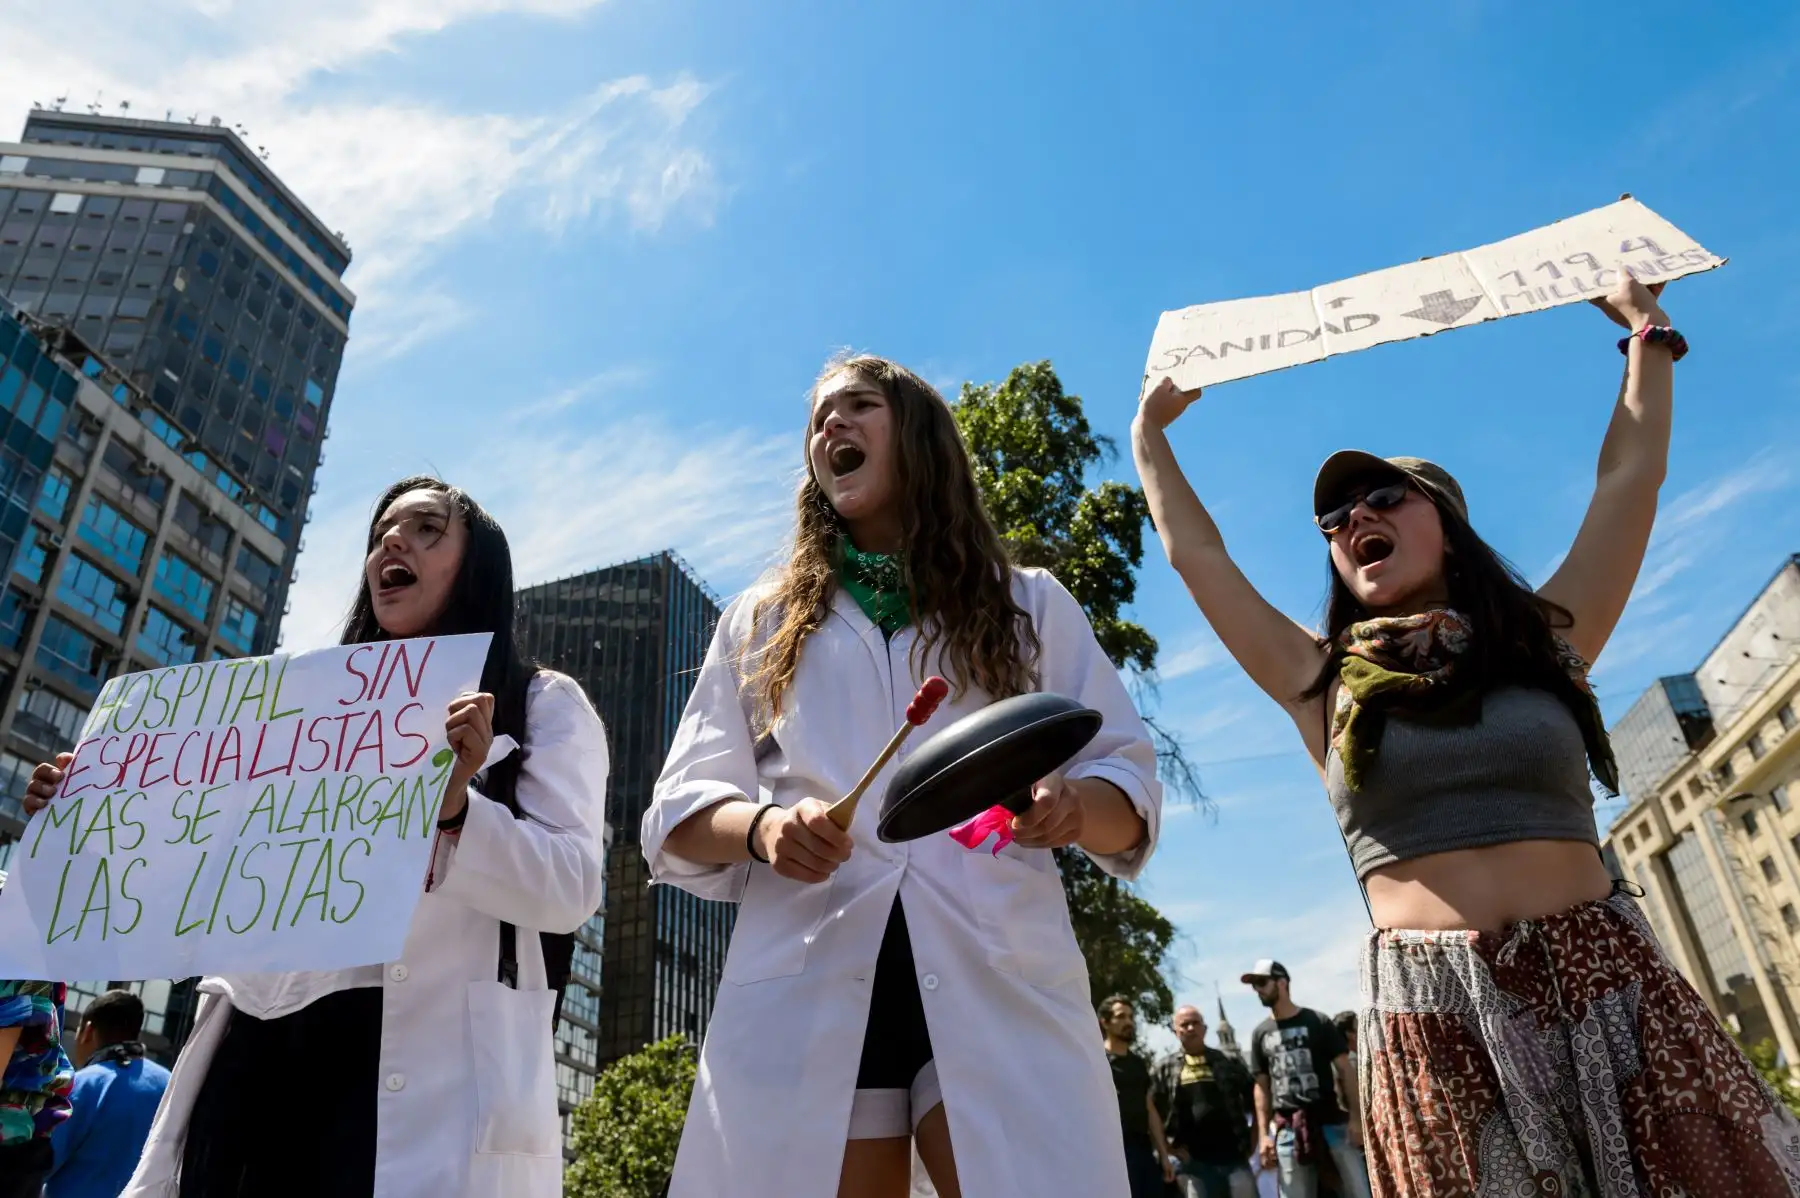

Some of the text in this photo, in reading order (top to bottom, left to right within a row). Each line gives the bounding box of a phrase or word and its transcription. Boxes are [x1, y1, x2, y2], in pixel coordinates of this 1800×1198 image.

[1501, 248, 1709, 310] MILLONES
[1152, 313, 1381, 371] SANIDAD
[83, 640, 436, 735] HOSPITAL SIN
[30, 774, 447, 859] MÁS SE ALARGAN
[47, 837, 371, 945] LAS LISTAS
